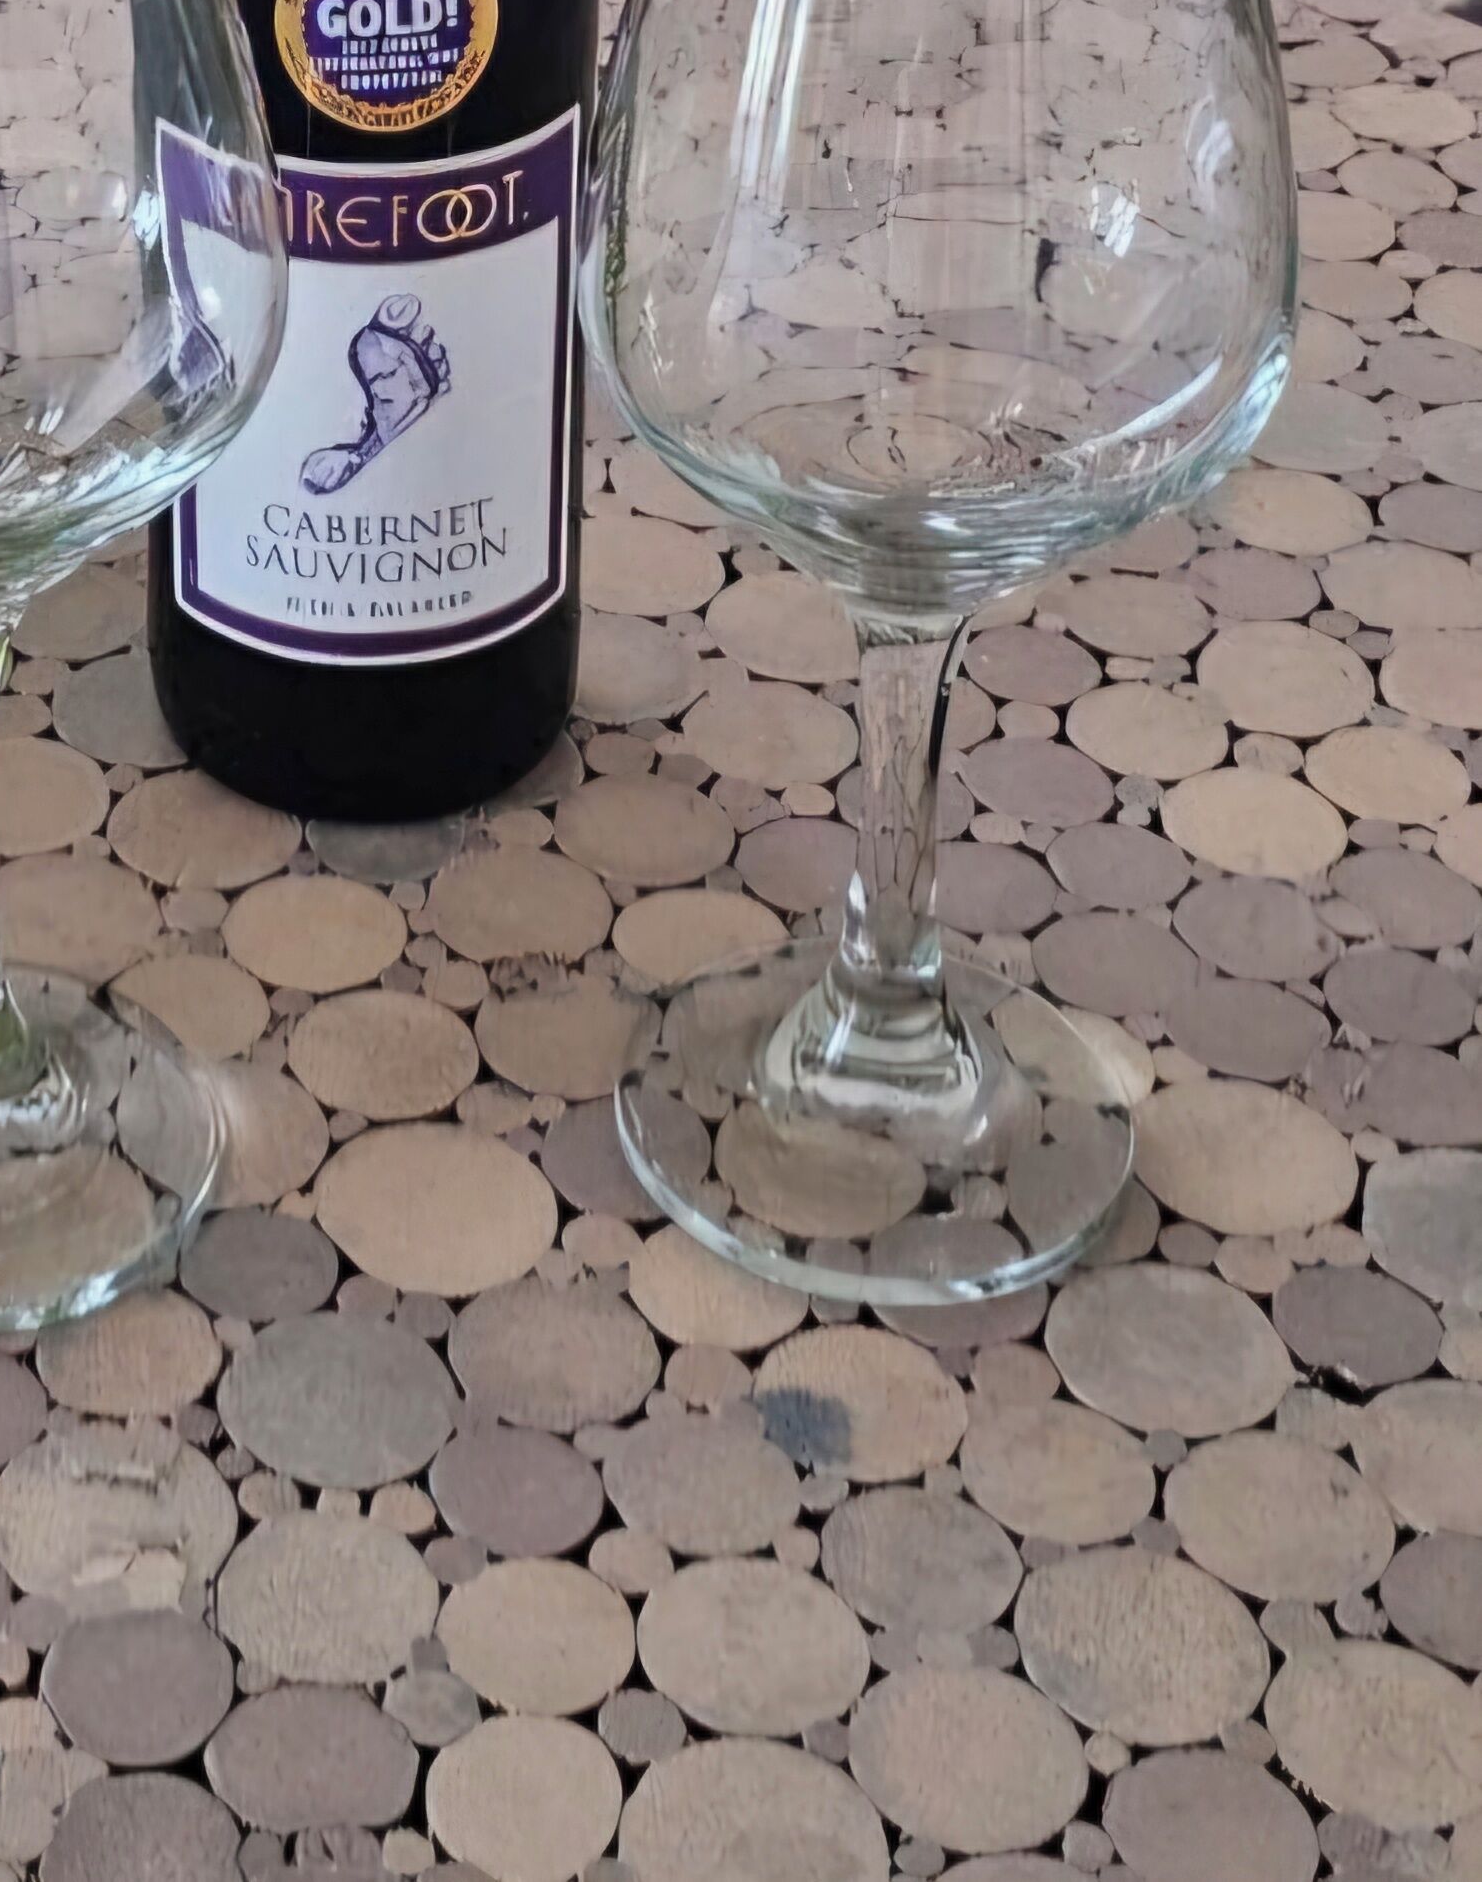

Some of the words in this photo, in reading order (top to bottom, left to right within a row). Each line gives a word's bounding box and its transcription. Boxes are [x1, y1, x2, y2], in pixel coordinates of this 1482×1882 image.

[280, 170, 524, 251] REFOOT
[262, 496, 494, 545] CABERNET
[245, 527, 508, 584] SAUVIGNON
